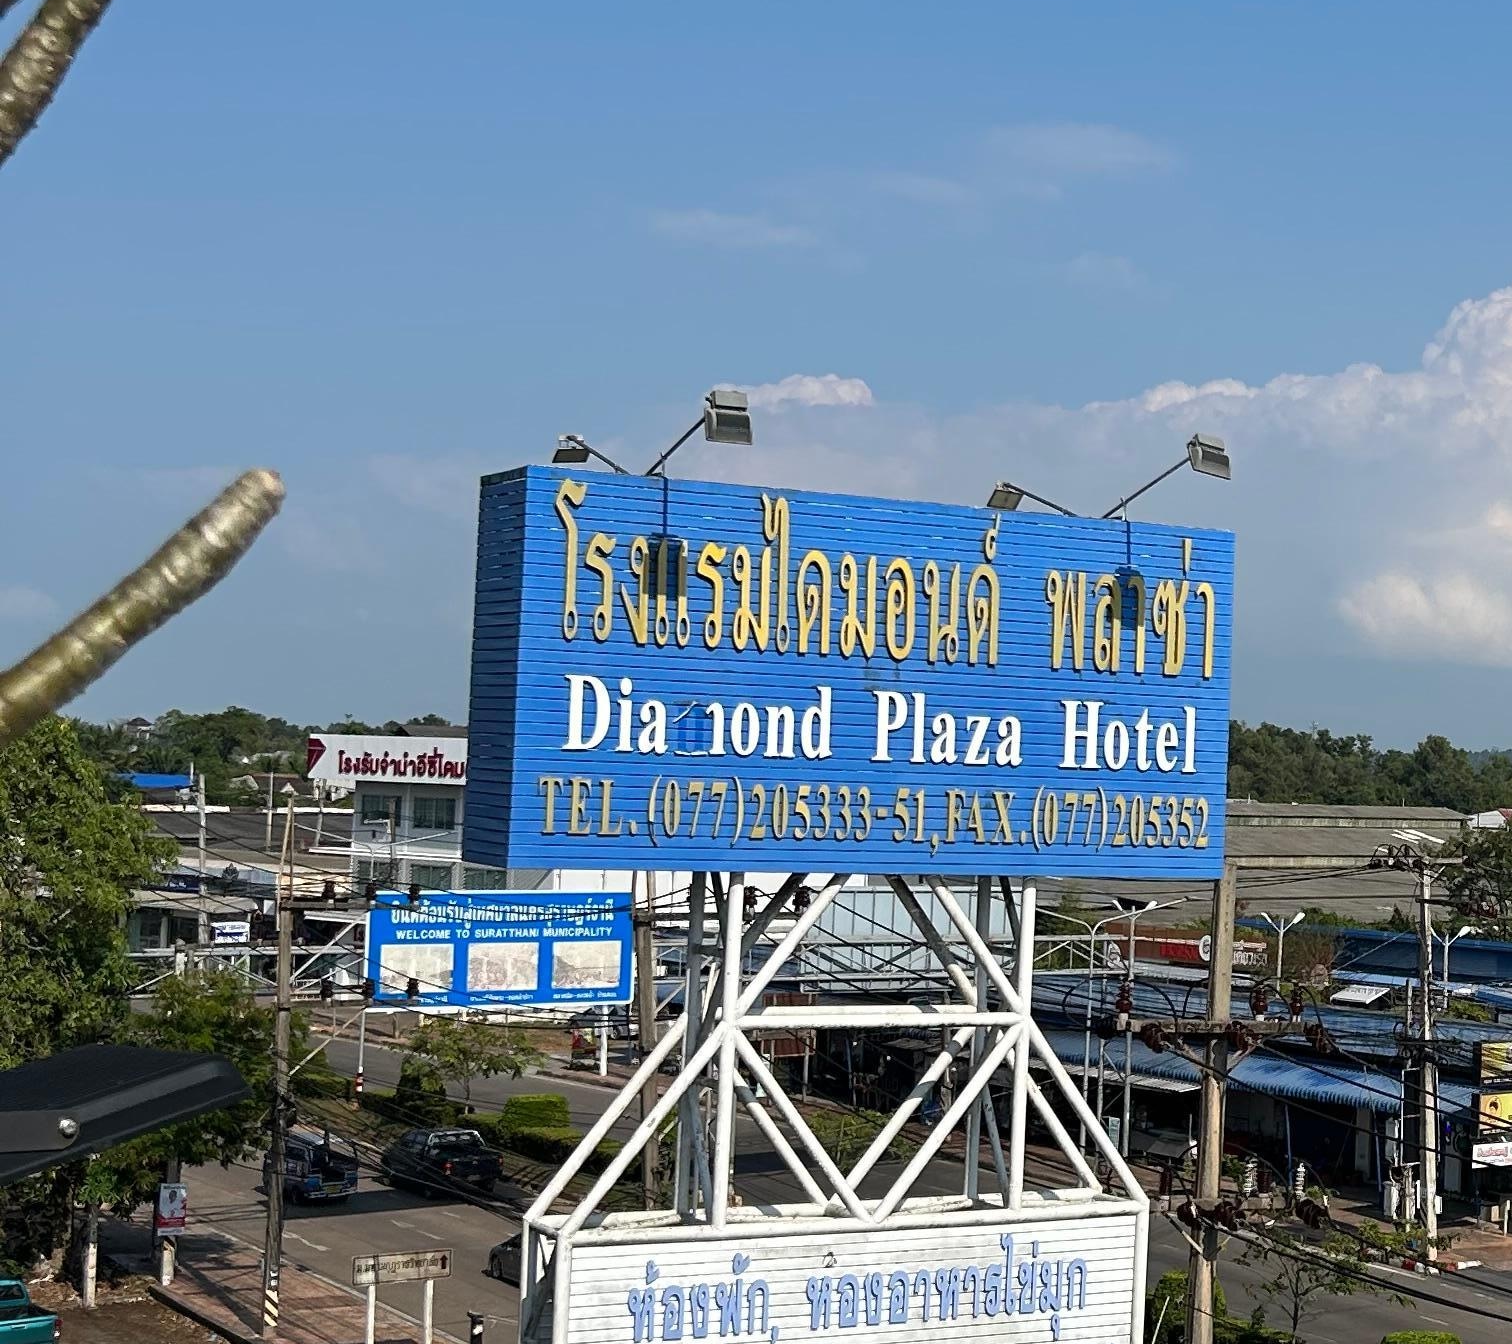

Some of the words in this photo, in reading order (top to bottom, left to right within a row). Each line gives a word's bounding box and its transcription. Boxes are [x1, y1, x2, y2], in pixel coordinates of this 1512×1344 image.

[554, 476, 1003, 668] โรงแรมไดมอนด์
[1045, 538, 1216, 681] พลาซ่า
[870, 690, 1023, 767] Plaza
[1058, 699, 1198, 773] Hotel
[396, 929, 451, 940] WELCOME
[456, 929, 471, 939] TO
[474, 927, 540, 938] SURATTHANI
[543, 926, 613, 937] MUNICIPALITY
